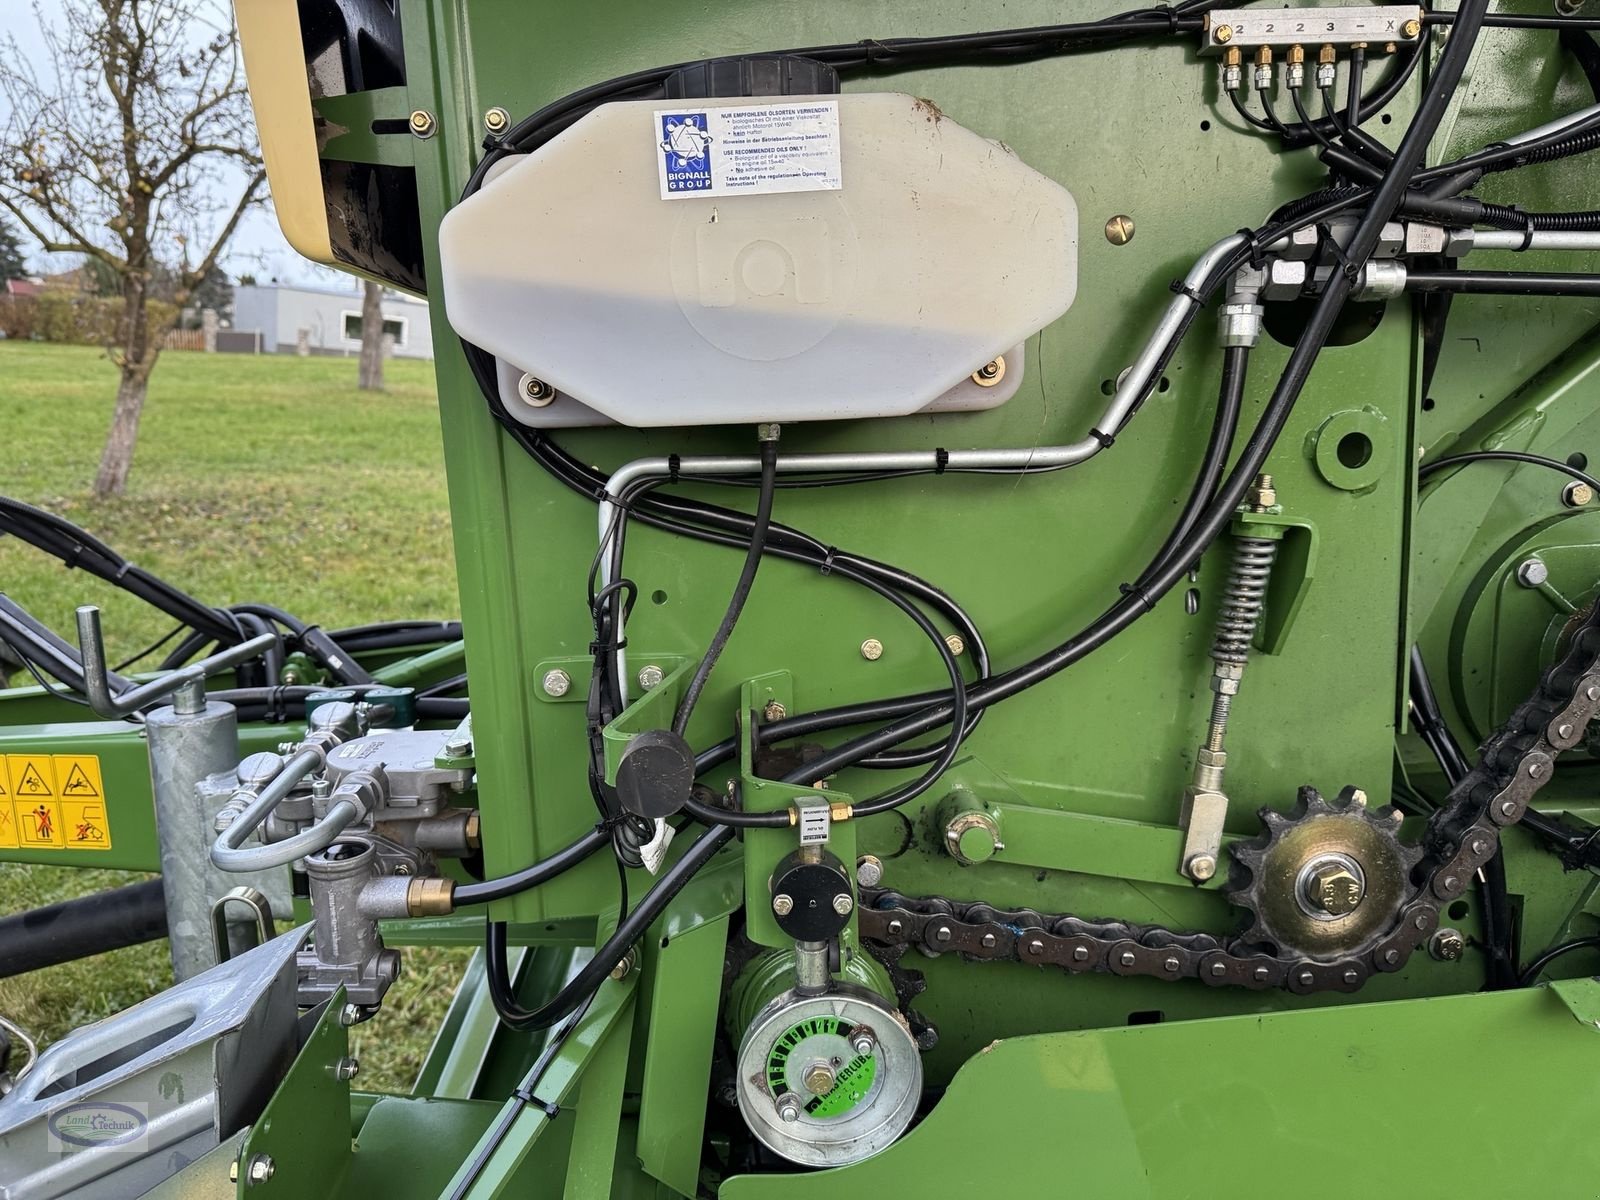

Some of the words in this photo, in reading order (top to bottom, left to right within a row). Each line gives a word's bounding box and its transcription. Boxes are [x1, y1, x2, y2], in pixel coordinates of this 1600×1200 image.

[1235, 24, 1244, 34] 2
[1265, 23, 1274, 33] 2
[1295, 23, 1305, 32] 2
[1326, 22, 1335, 32] 3
[1386, 20, 1395, 30] X
[668, 171, 711, 181] BIGNALL
[669, 180, 711, 189] GROUP
